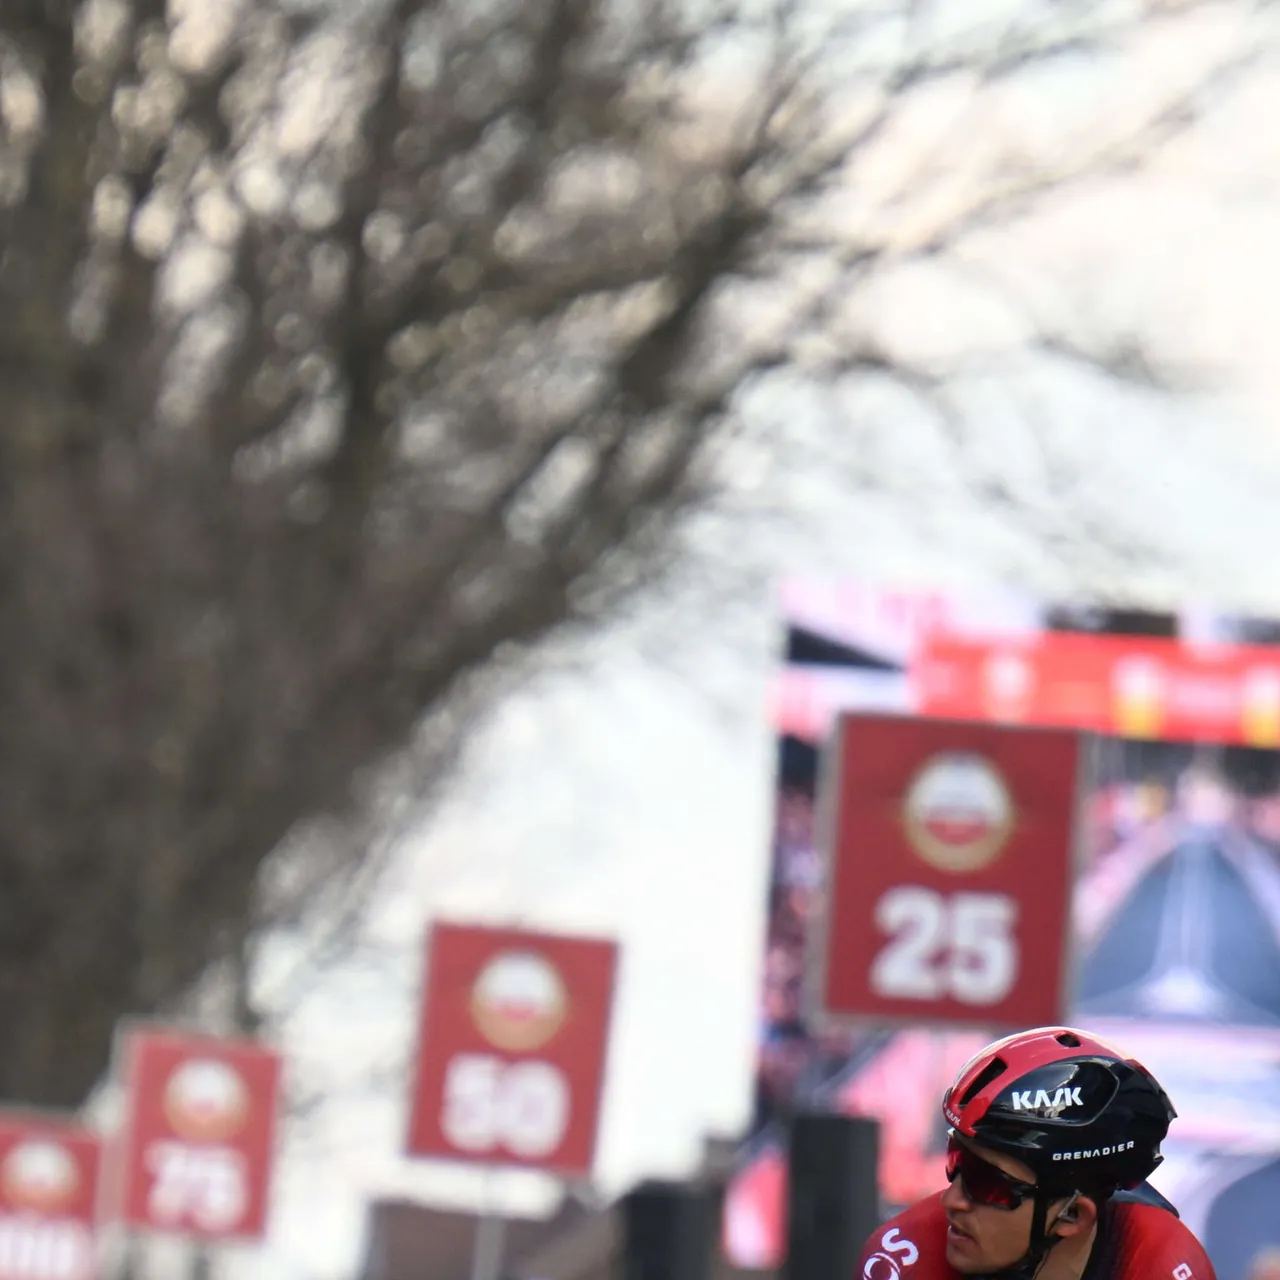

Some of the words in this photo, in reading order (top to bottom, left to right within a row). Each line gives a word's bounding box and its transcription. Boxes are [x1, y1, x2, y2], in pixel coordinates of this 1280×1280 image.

[870, 884, 1020, 1005] 25
[439, 1052, 572, 1160] 50
[1012, 1087, 1084, 1110] KASK
[144, 1140, 250, 1232] 75
[1052, 1140, 1134, 1161] GRENADIER
